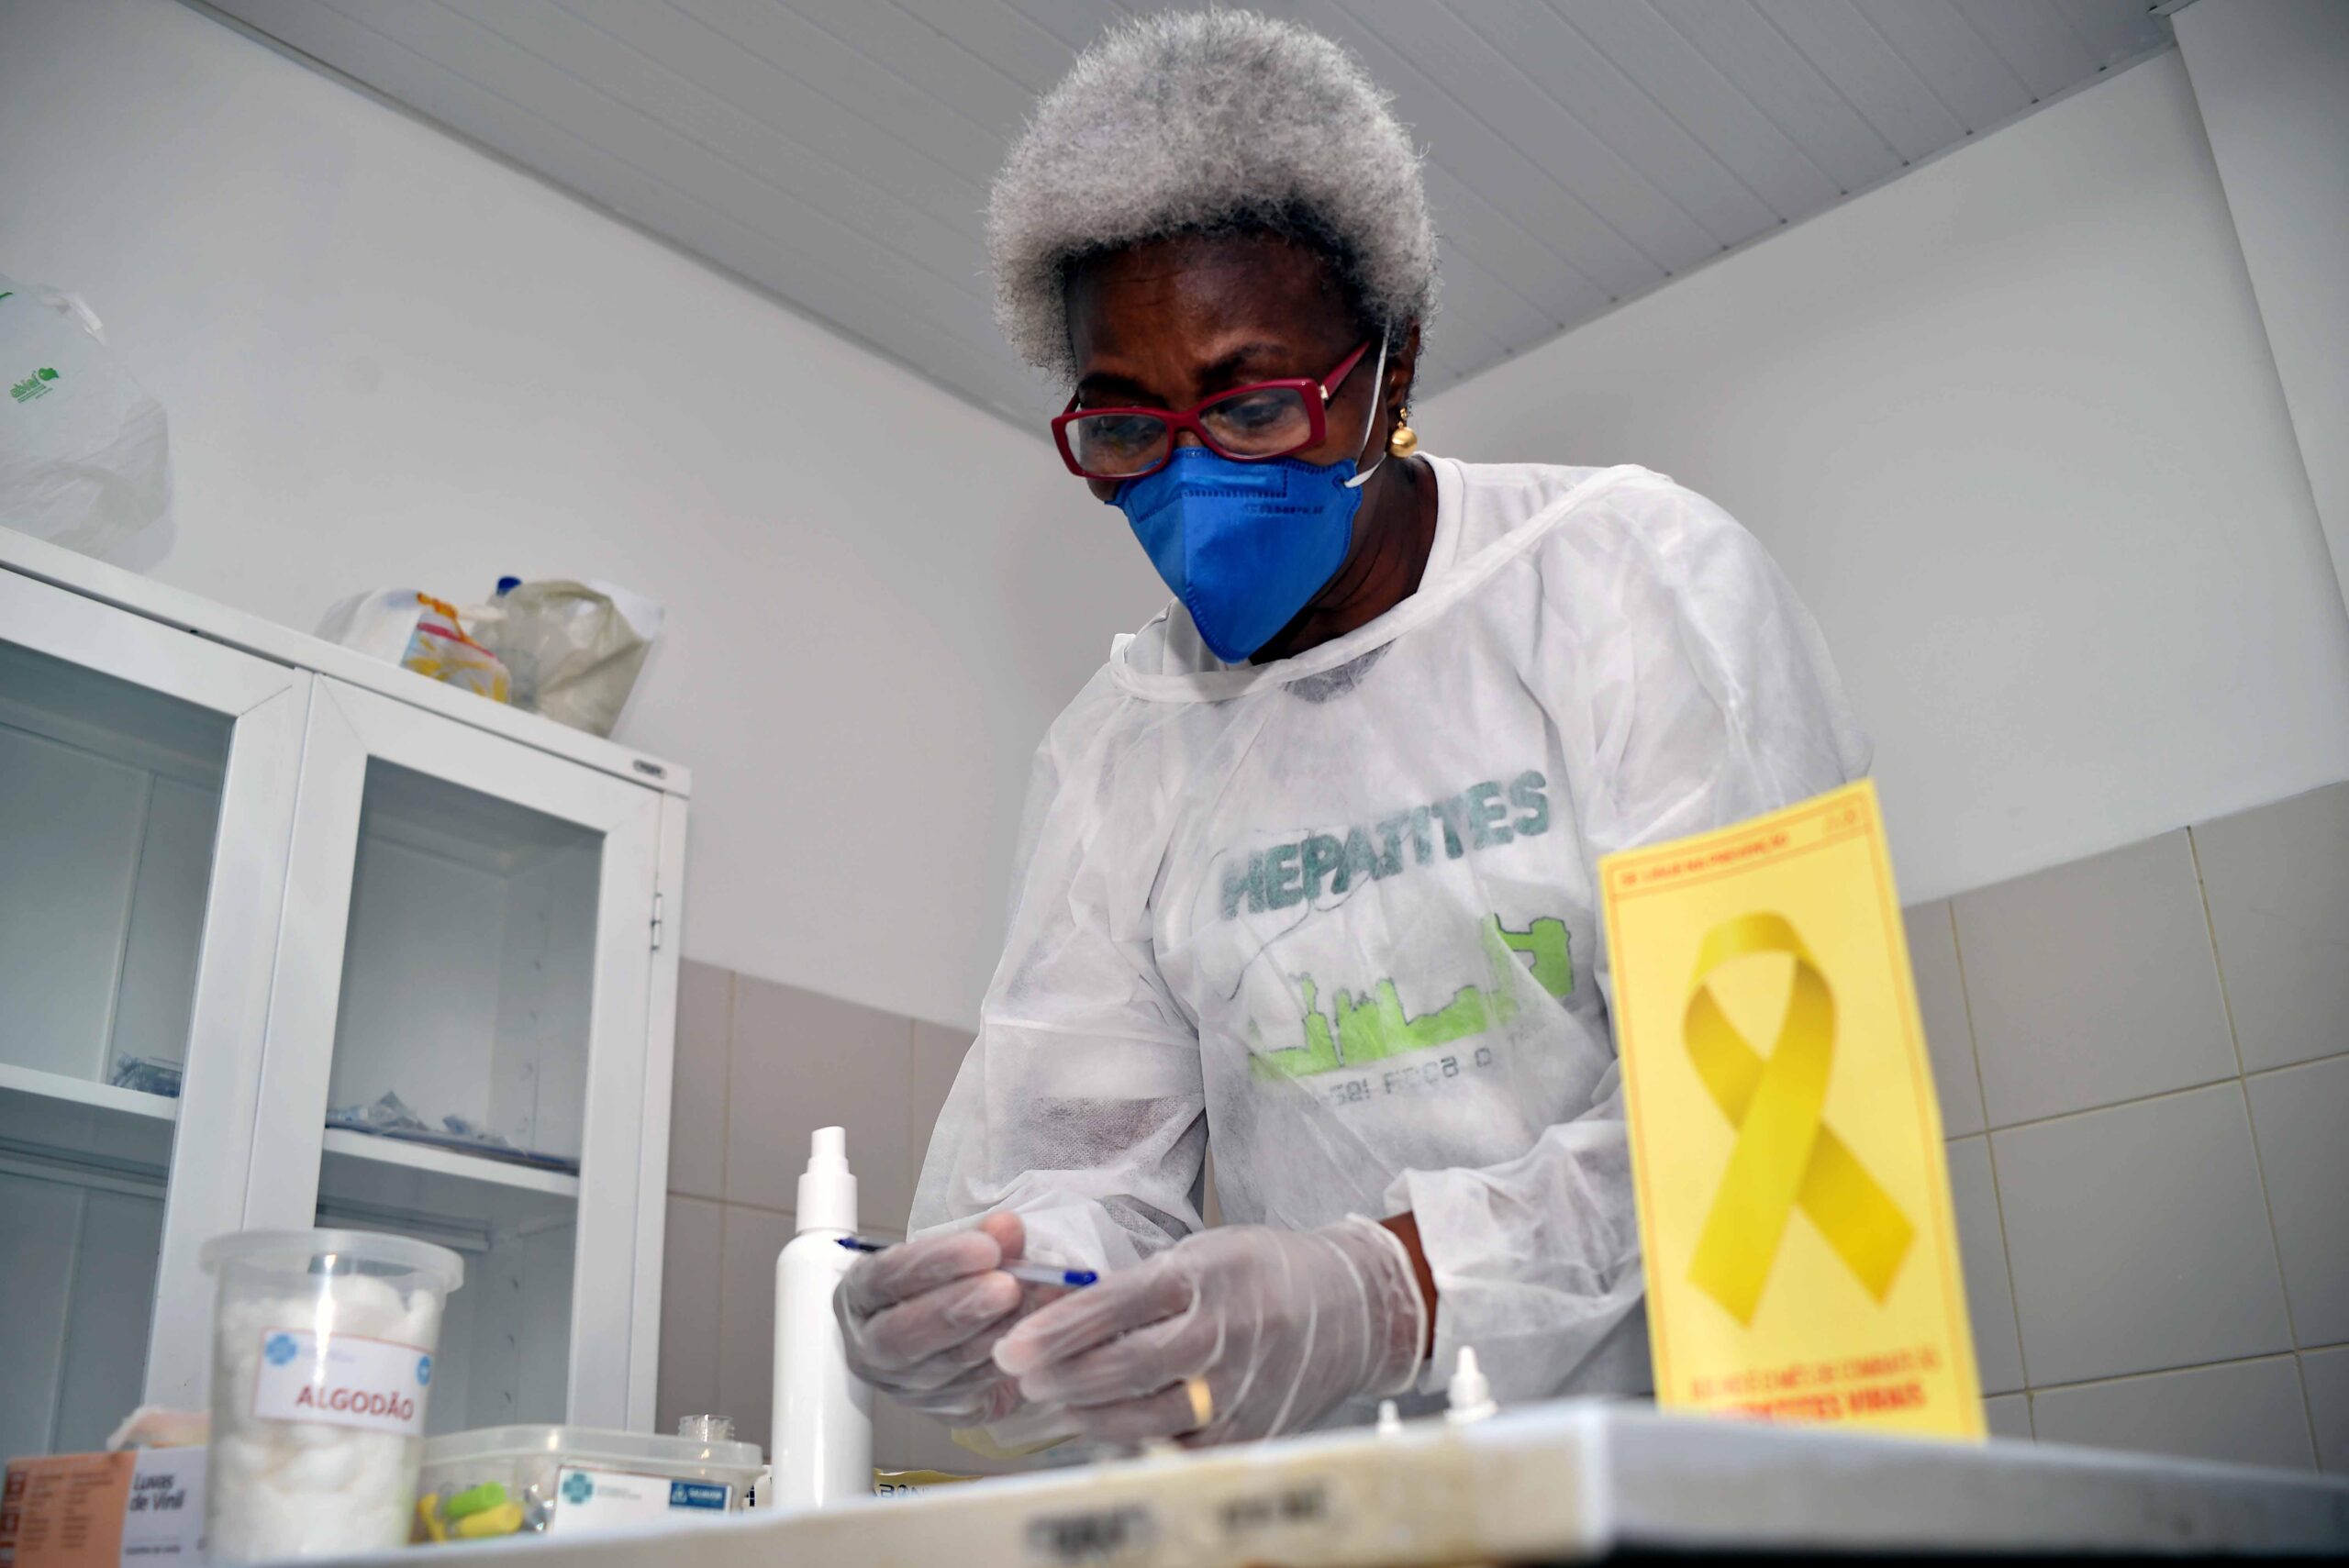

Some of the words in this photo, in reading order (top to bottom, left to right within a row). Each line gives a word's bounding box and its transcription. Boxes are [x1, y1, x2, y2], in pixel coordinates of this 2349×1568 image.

[1219, 769, 1550, 919] HEPATITES
[295, 1385, 414, 1421] ALGODÃO
[134, 1474, 173, 1491] Luvas
[129, 1496, 149, 1511] de
[152, 1490, 187, 1511] Vinil
